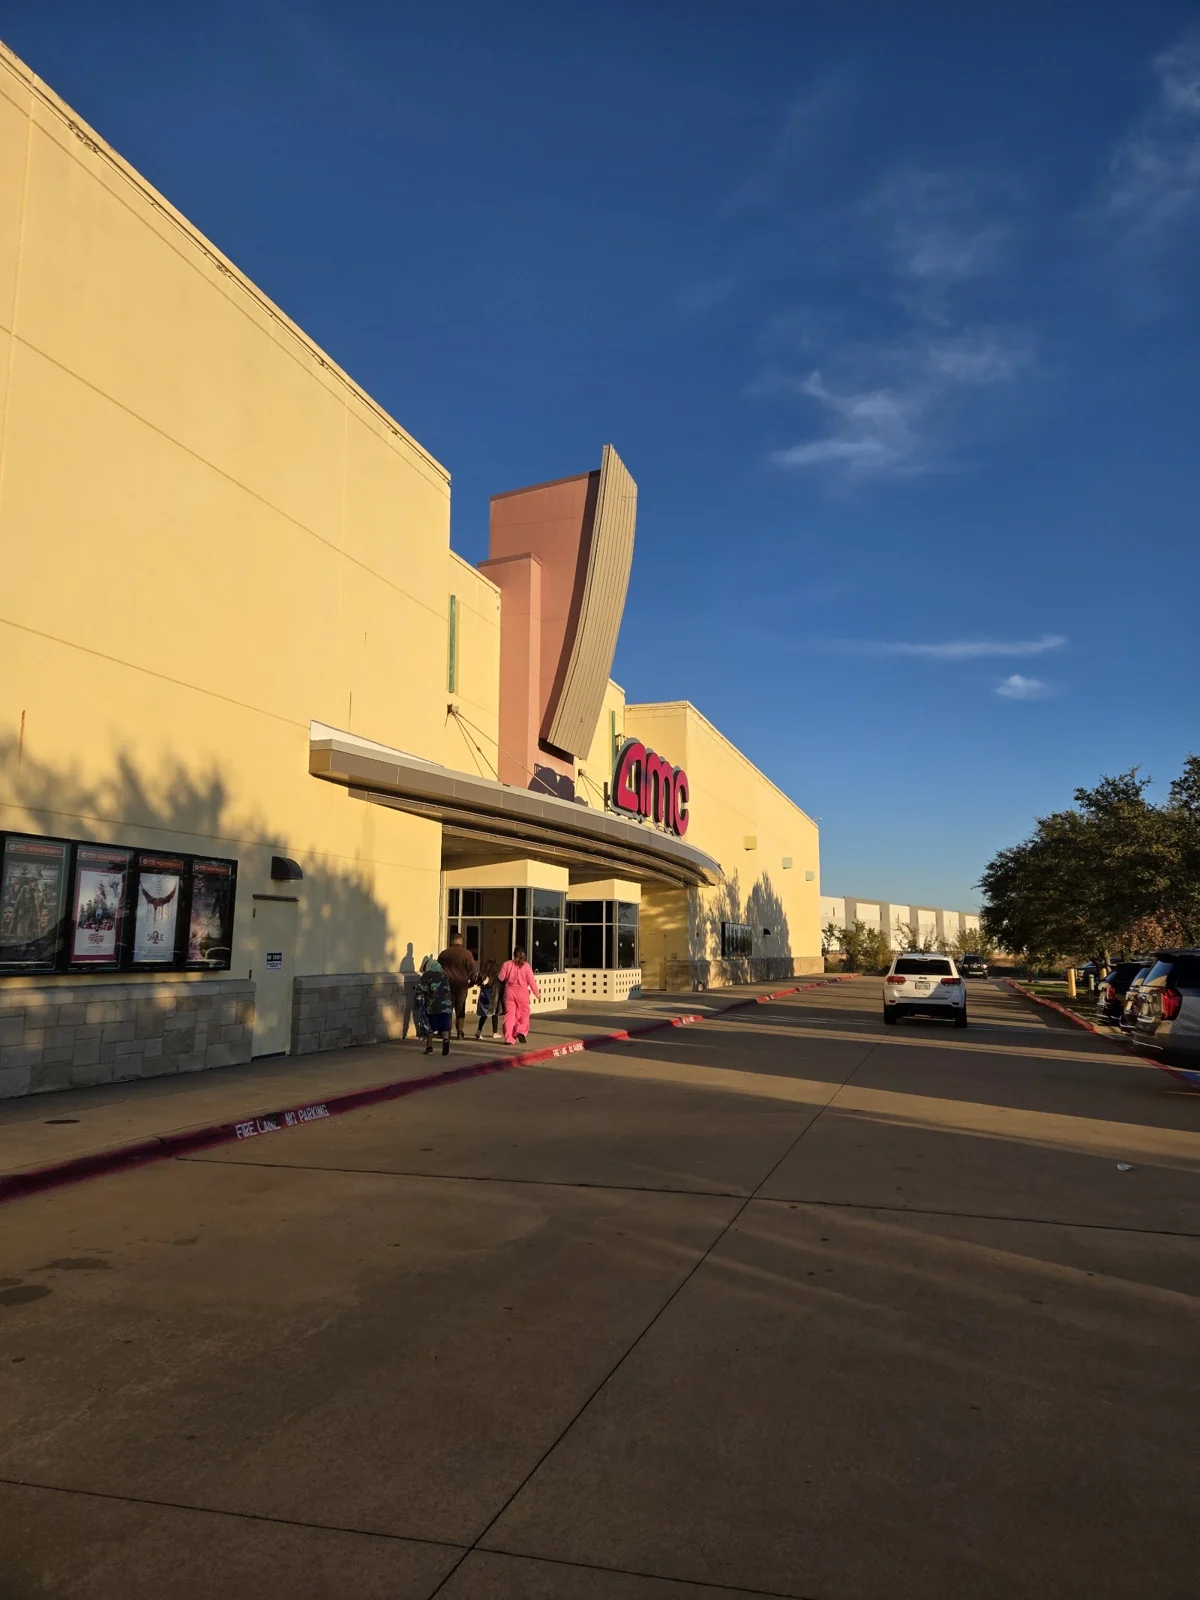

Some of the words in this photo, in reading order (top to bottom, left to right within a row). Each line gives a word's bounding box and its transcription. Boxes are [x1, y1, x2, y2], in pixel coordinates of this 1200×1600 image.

[612, 739, 689, 837] amc
[147, 933, 164, 942] SMLE
[235, 1121, 257, 1139] FIRE
[256, 1119, 281, 1133] LANE
[285, 1111, 298, 1127] NO
[298, 1104, 330, 1123] PARKING
